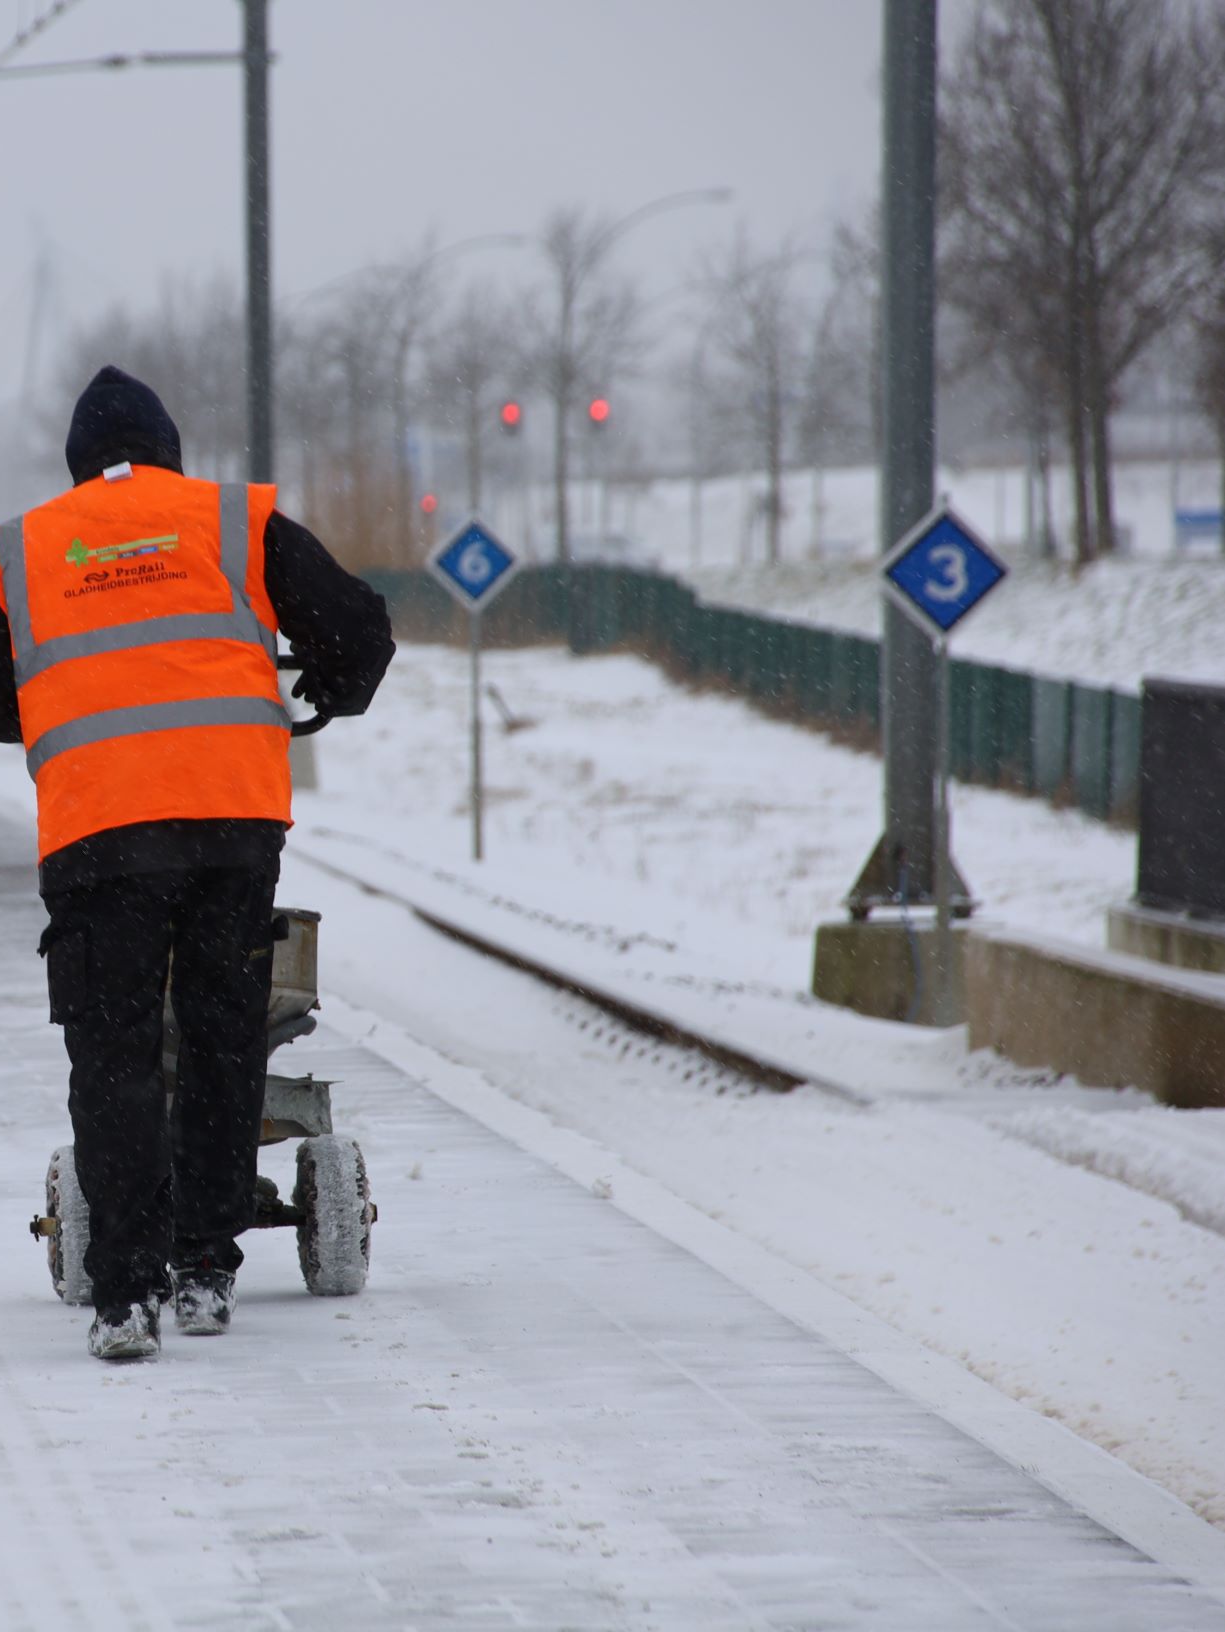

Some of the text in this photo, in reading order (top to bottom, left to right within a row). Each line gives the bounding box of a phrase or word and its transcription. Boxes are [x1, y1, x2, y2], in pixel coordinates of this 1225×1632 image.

[115, 562, 165, 578] ProRail
[458, 543, 491, 583] 6
[925, 544, 967, 602] 3
[64, 571, 188, 599] GLADHEIDBESTRIJDING
